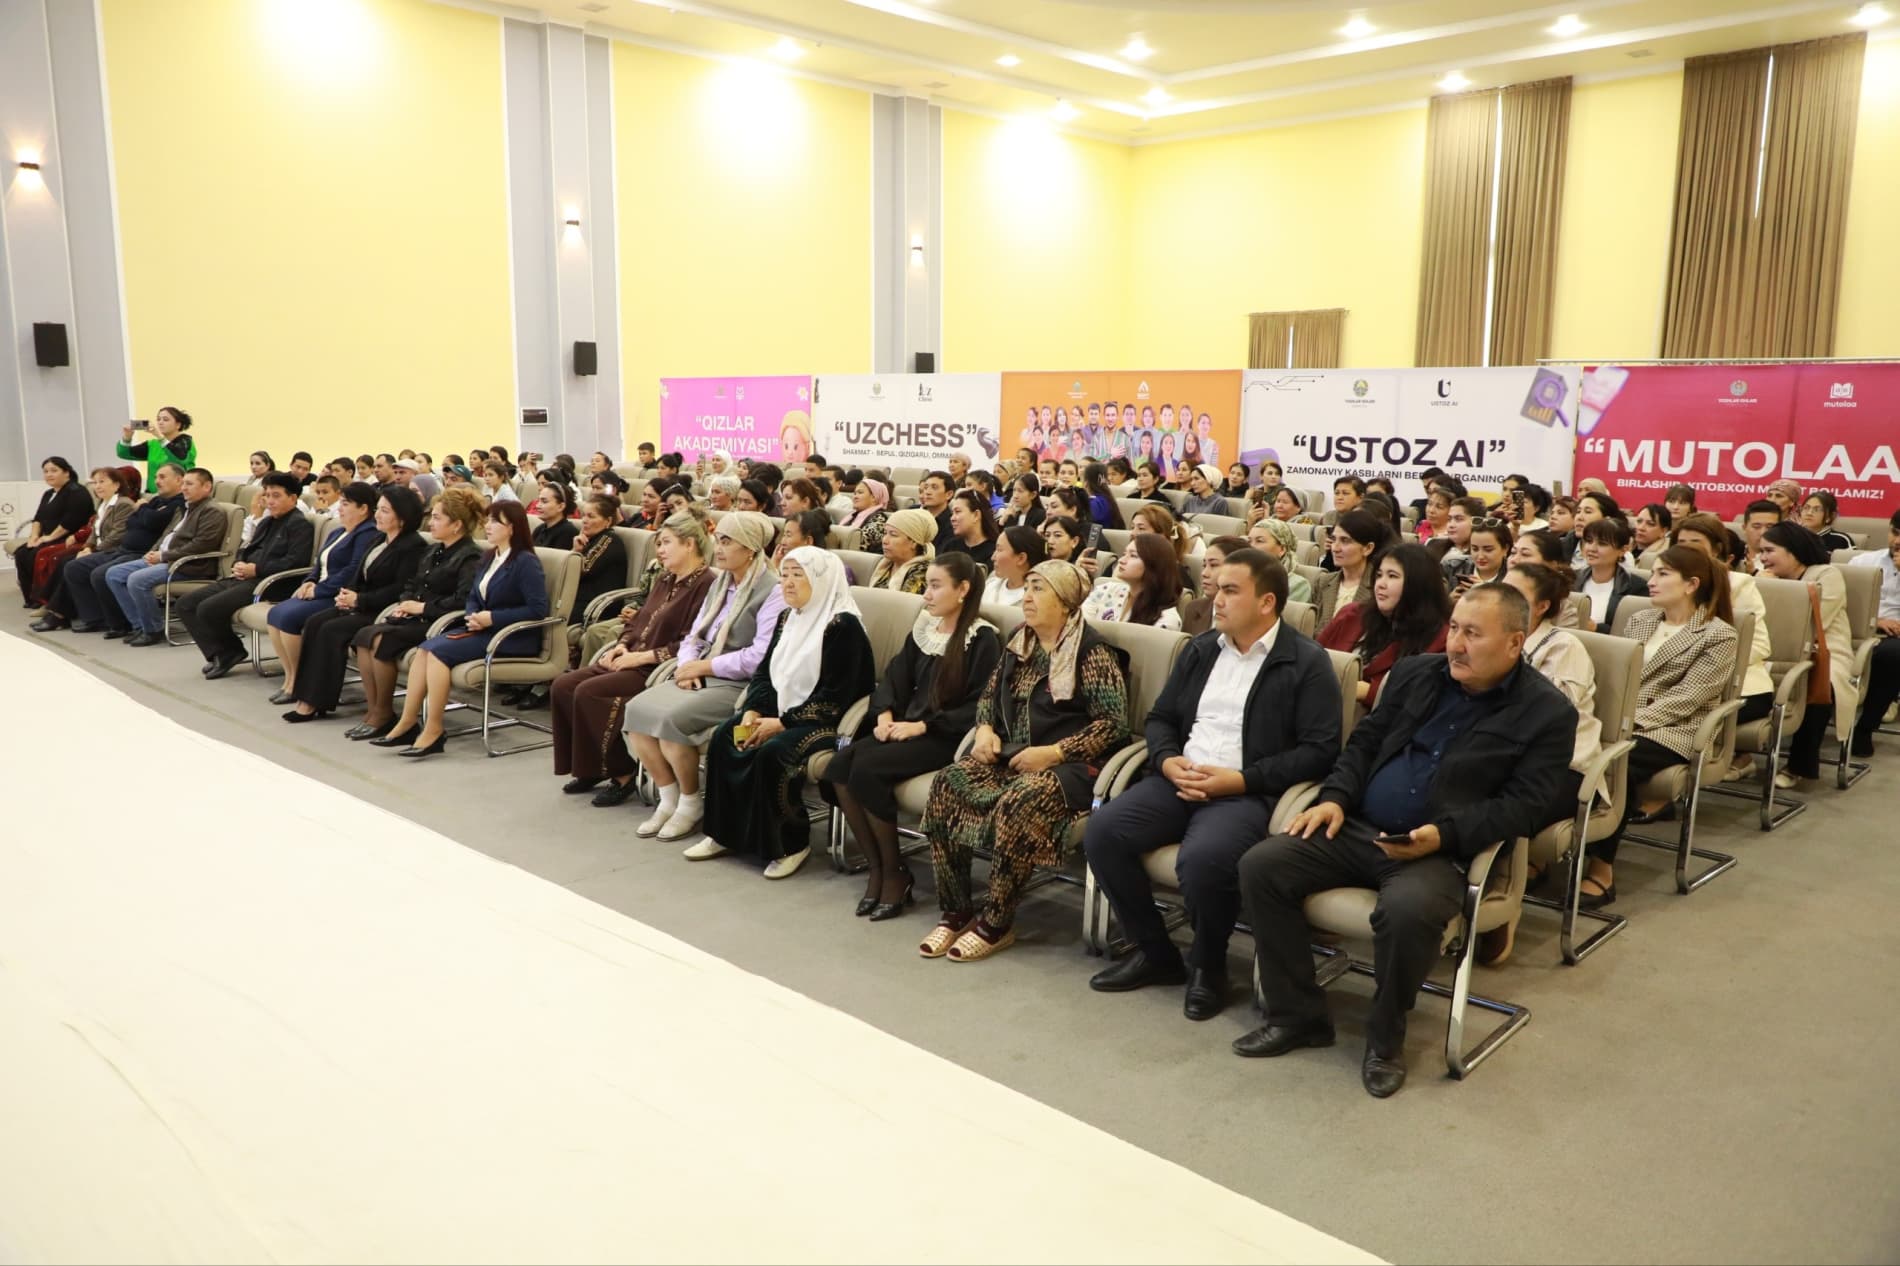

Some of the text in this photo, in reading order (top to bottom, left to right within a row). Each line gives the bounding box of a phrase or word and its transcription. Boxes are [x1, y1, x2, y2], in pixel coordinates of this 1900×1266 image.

[835, 422, 977, 448] “UZCHESS”
[1293, 435, 1506, 468] “USTOZ AI”
[1286, 466, 1344, 476] ZAMONAVIY
[1345, 469, 1403, 479] KASBLARNI
[1687, 481, 1755, 493] KITOBXON
